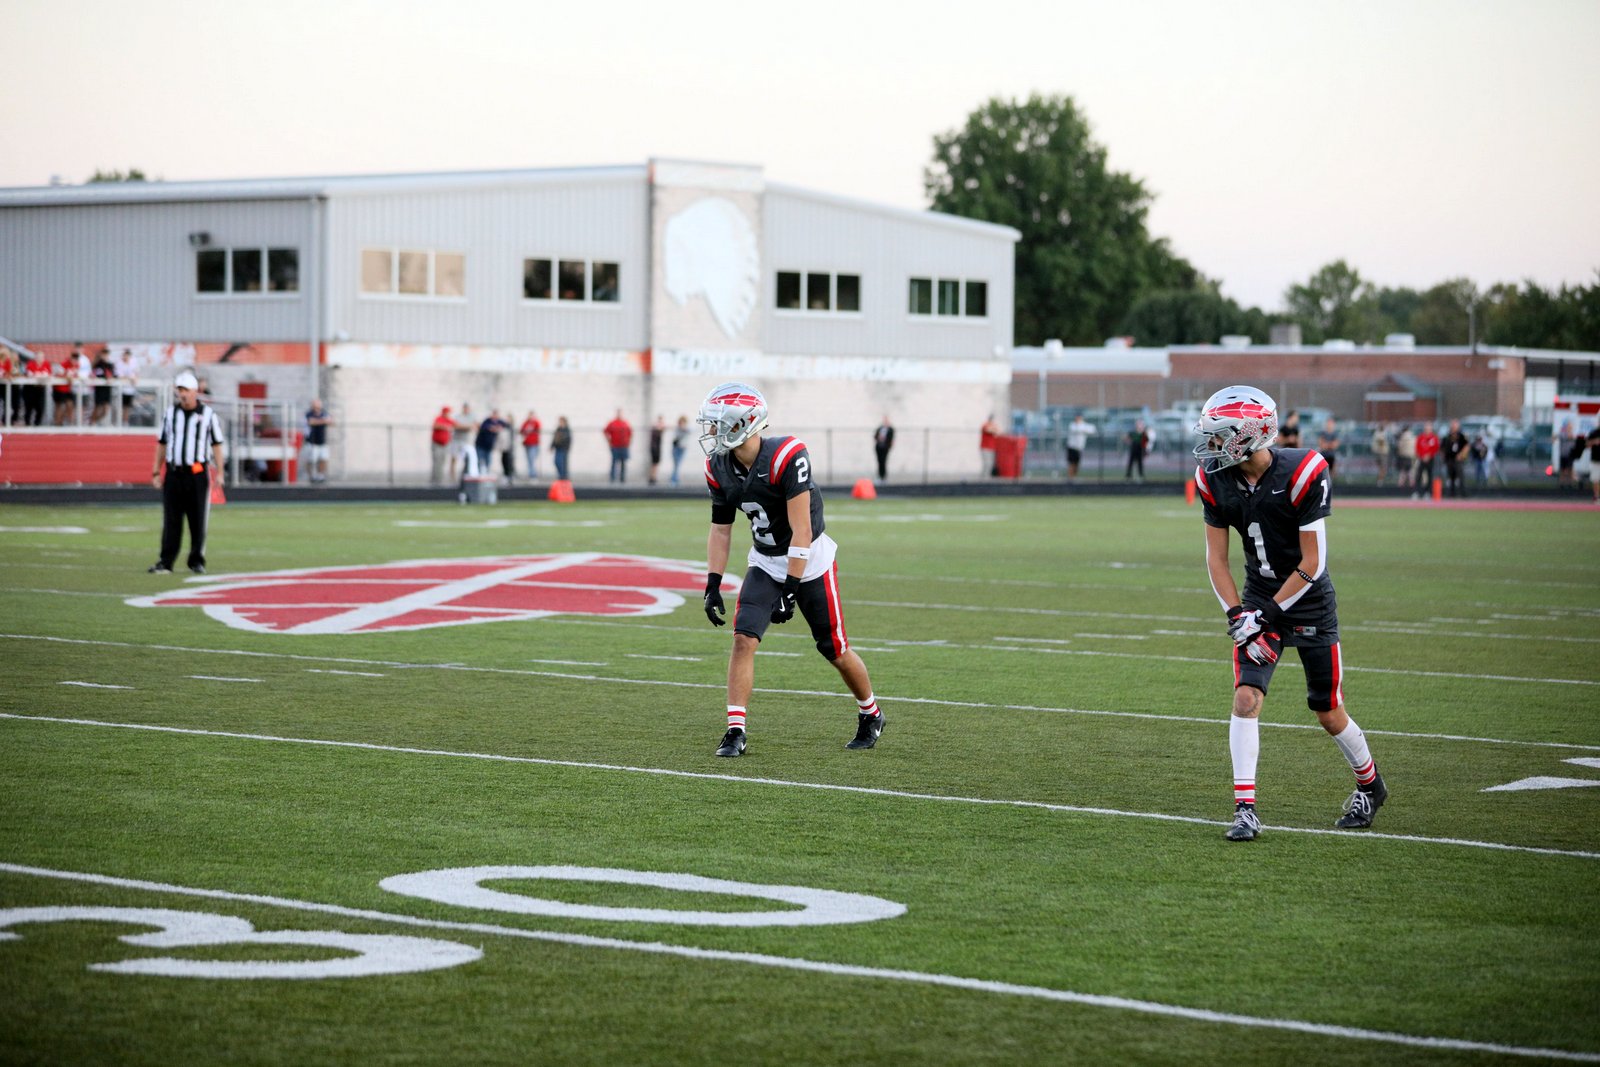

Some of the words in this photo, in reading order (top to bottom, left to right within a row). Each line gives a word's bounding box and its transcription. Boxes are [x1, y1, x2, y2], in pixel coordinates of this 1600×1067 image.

[794, 456, 809, 484] 2
[1320, 479, 1329, 507] 1
[741, 501, 776, 546] 2
[1247, 522, 1277, 579] 1
